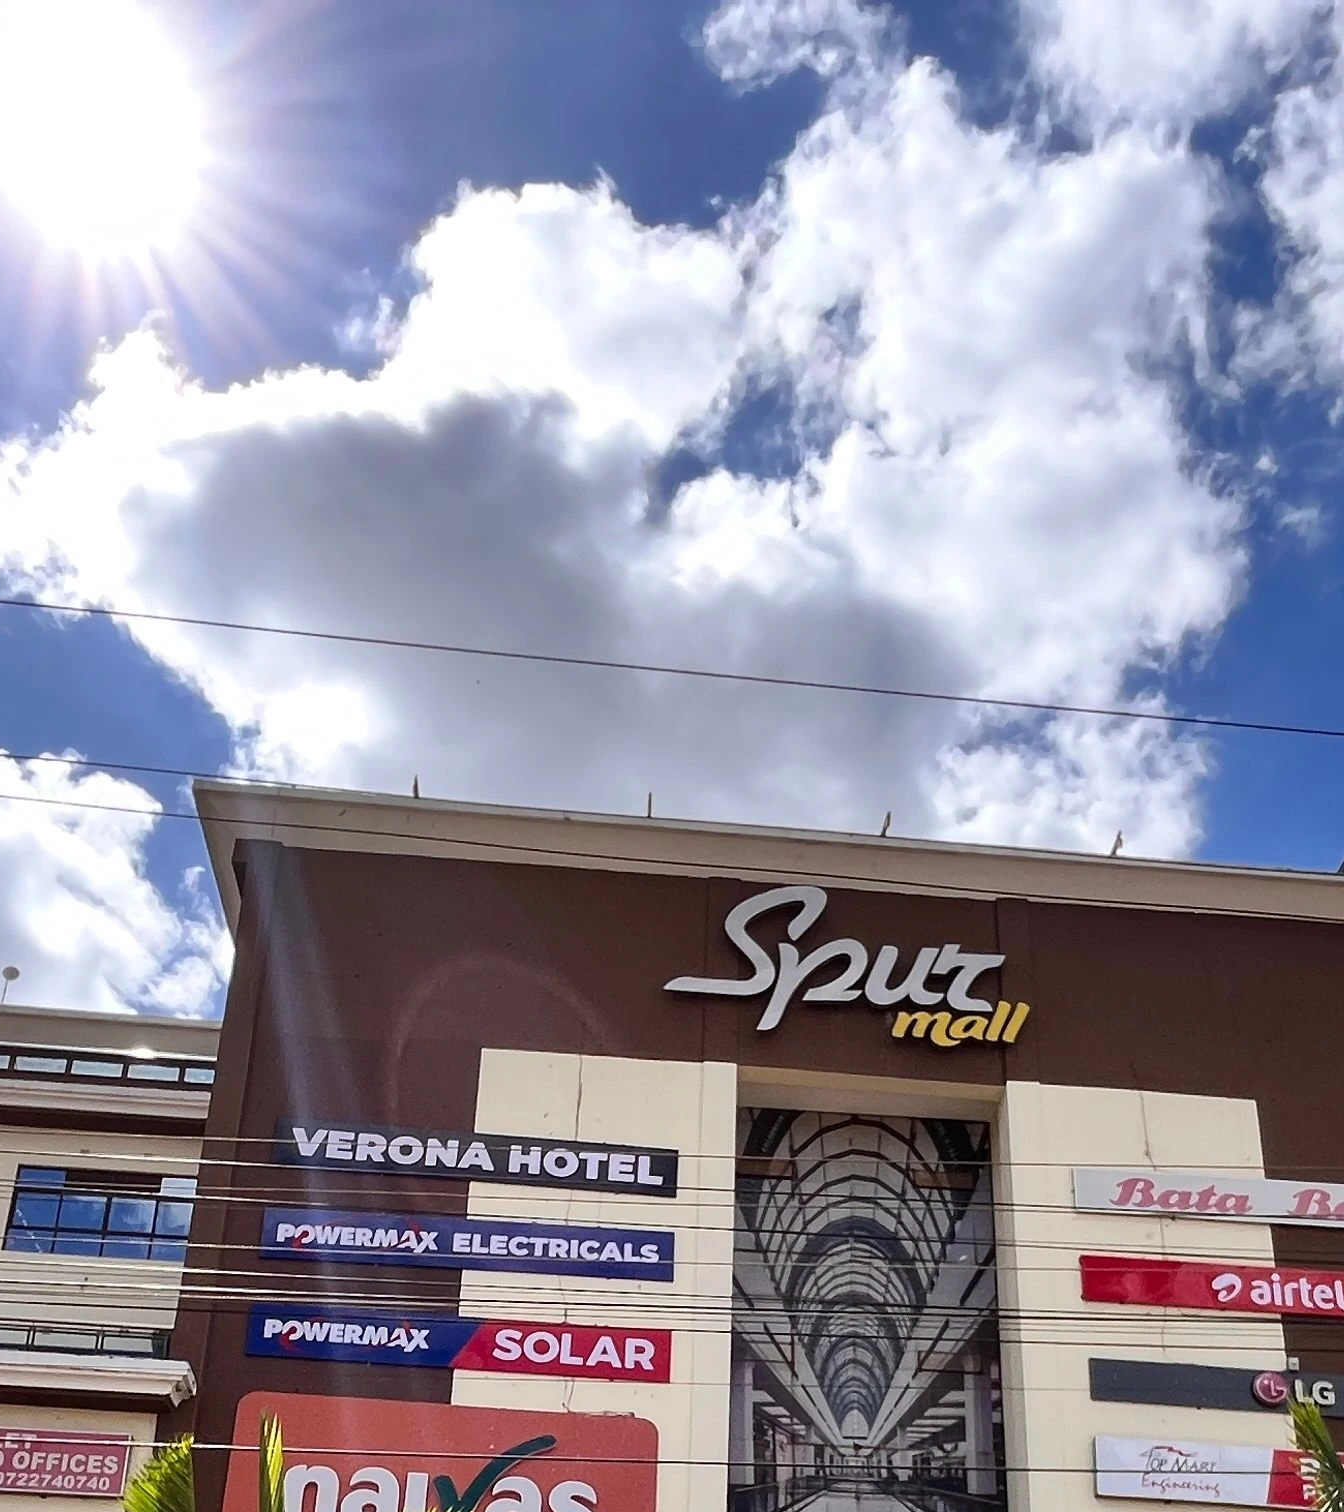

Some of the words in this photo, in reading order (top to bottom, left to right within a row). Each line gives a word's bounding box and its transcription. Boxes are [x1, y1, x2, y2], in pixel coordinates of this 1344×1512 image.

[662, 885, 1006, 1032] Spur
[891, 1000, 1031, 1047] mall
[291, 1127, 495, 1172] VERONA
[507, 1144, 664, 1187] HOTEL
[1109, 1177, 1254, 1216] Bata
[276, 1222, 439, 1254] POWERMAX
[452, 1231, 660, 1264] ELECTRICALS
[262, 1318, 431, 1353] POWERMAX
[491, 1328, 656, 1371] SOLAR
[1294, 1378, 1336, 1406] LG
[12, 1451, 119, 1475] OFFICES
